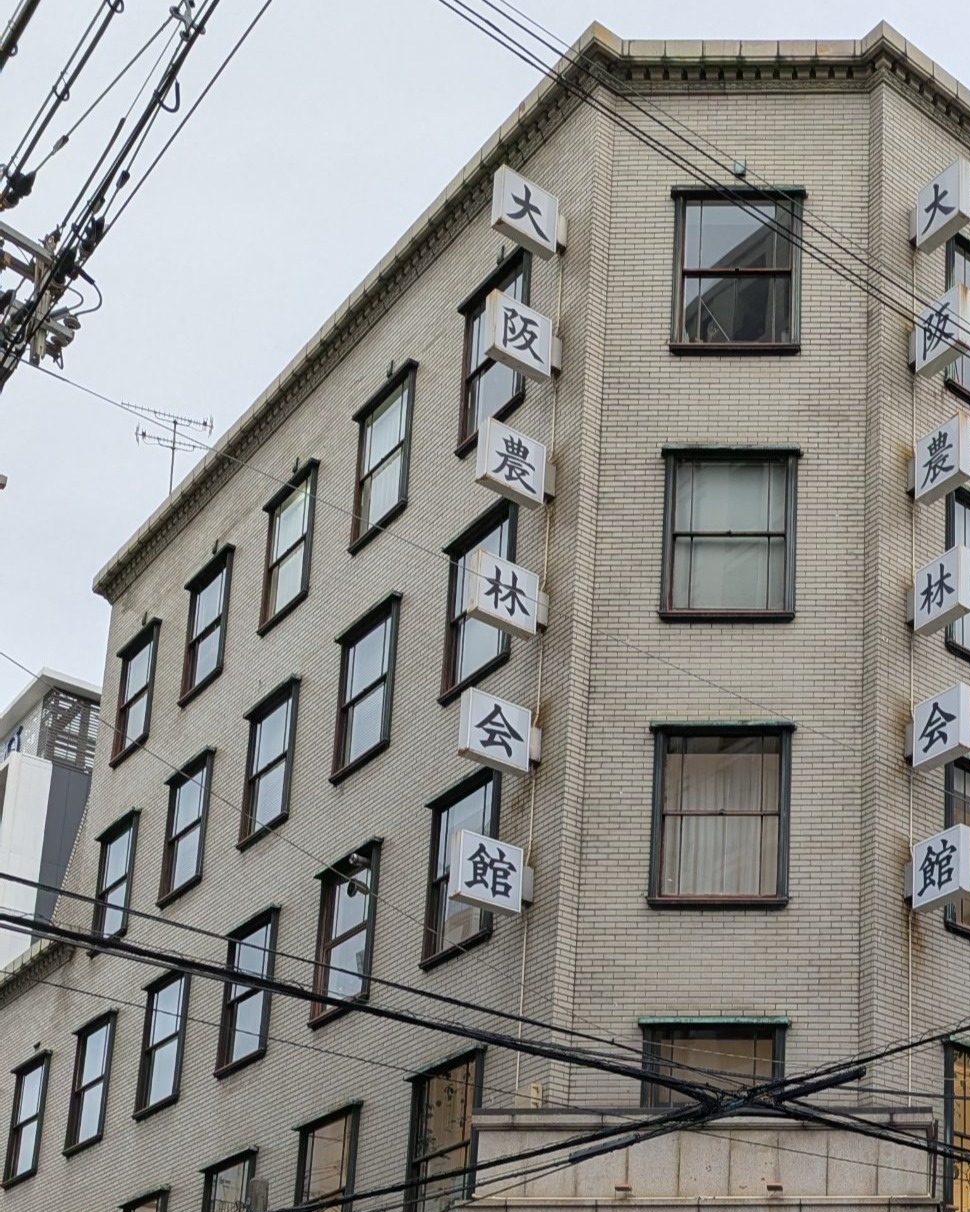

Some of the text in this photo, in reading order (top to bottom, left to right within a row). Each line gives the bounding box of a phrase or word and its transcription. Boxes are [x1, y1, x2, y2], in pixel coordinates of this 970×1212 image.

[917, 183, 957, 897] 大阪農林会館
